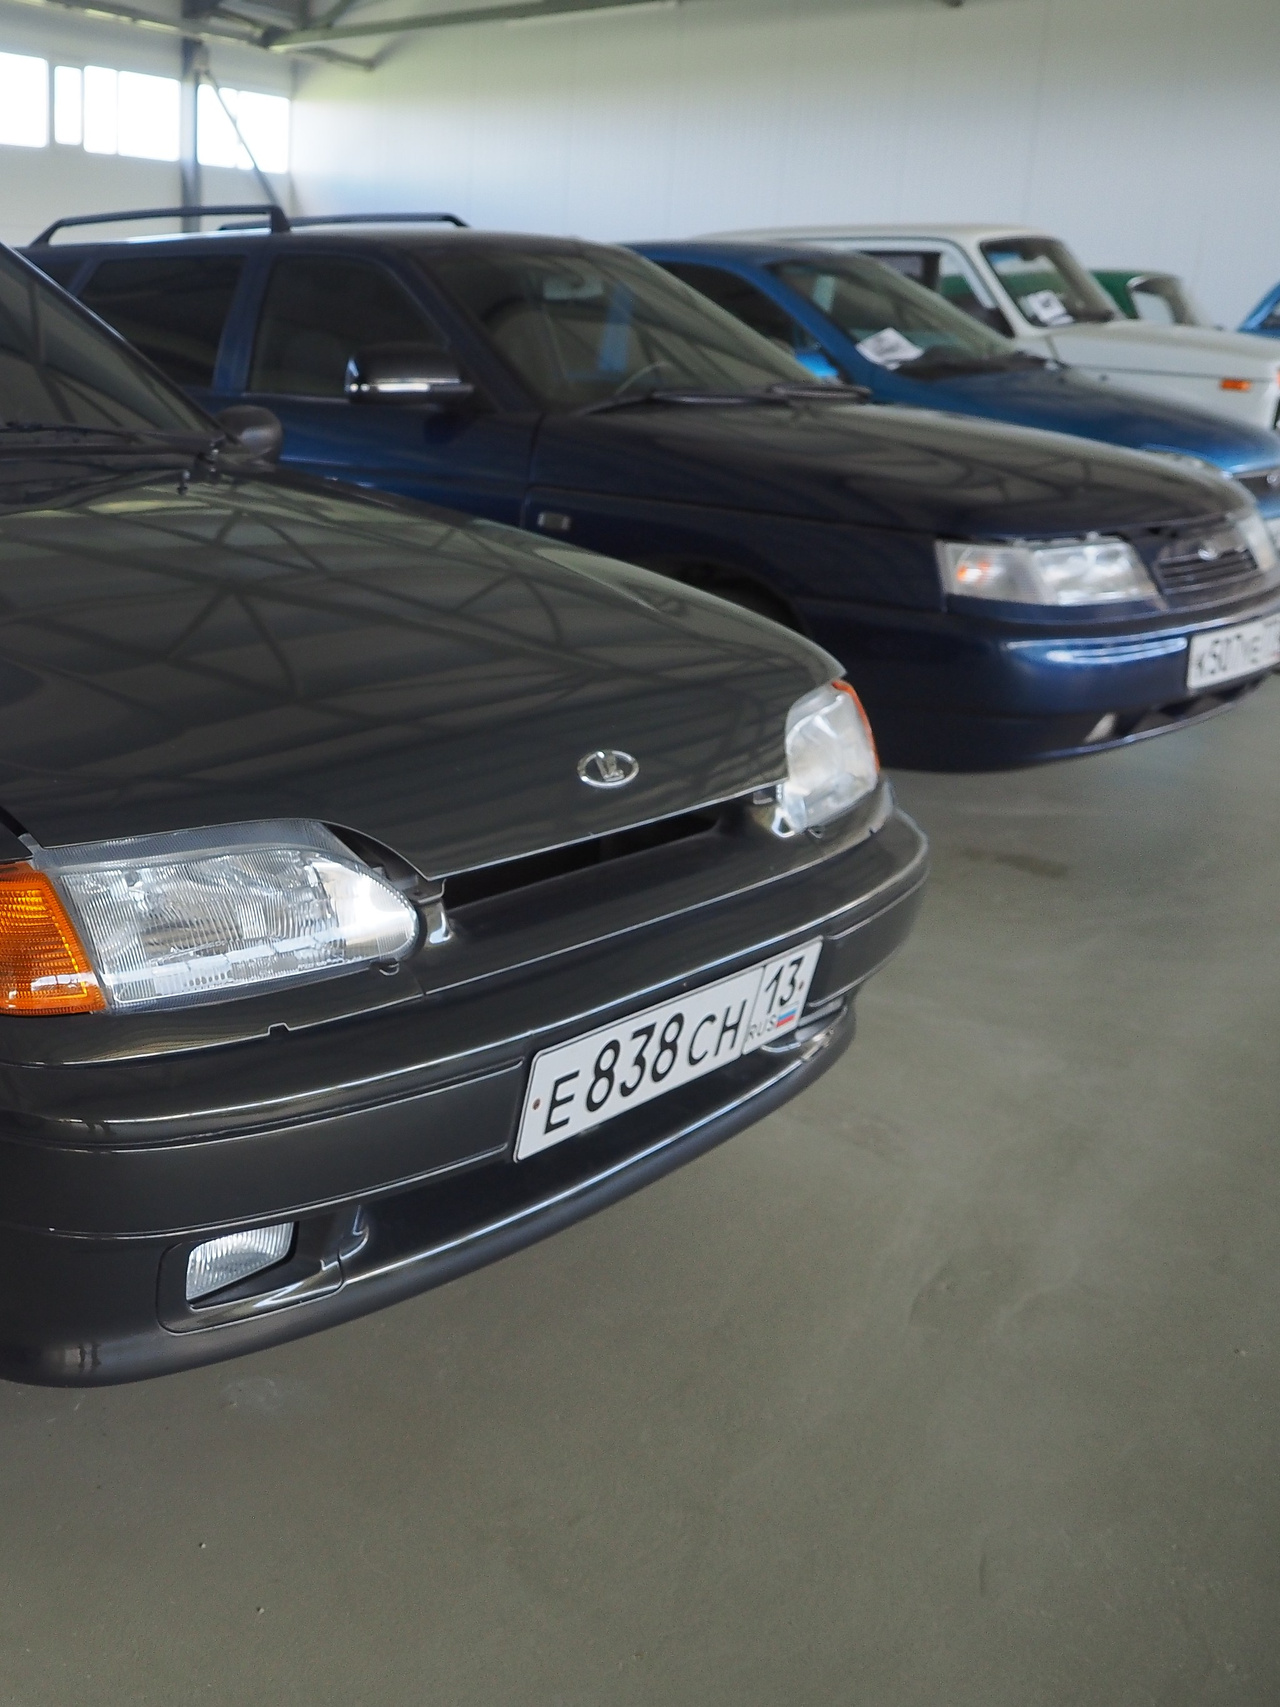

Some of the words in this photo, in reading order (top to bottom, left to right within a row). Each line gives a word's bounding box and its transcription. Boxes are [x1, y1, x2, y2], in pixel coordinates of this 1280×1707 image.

[543, 999, 748, 1135] E838CH
[764, 955, 805, 1016] 13
[748, 1014, 777, 1040] RUS
